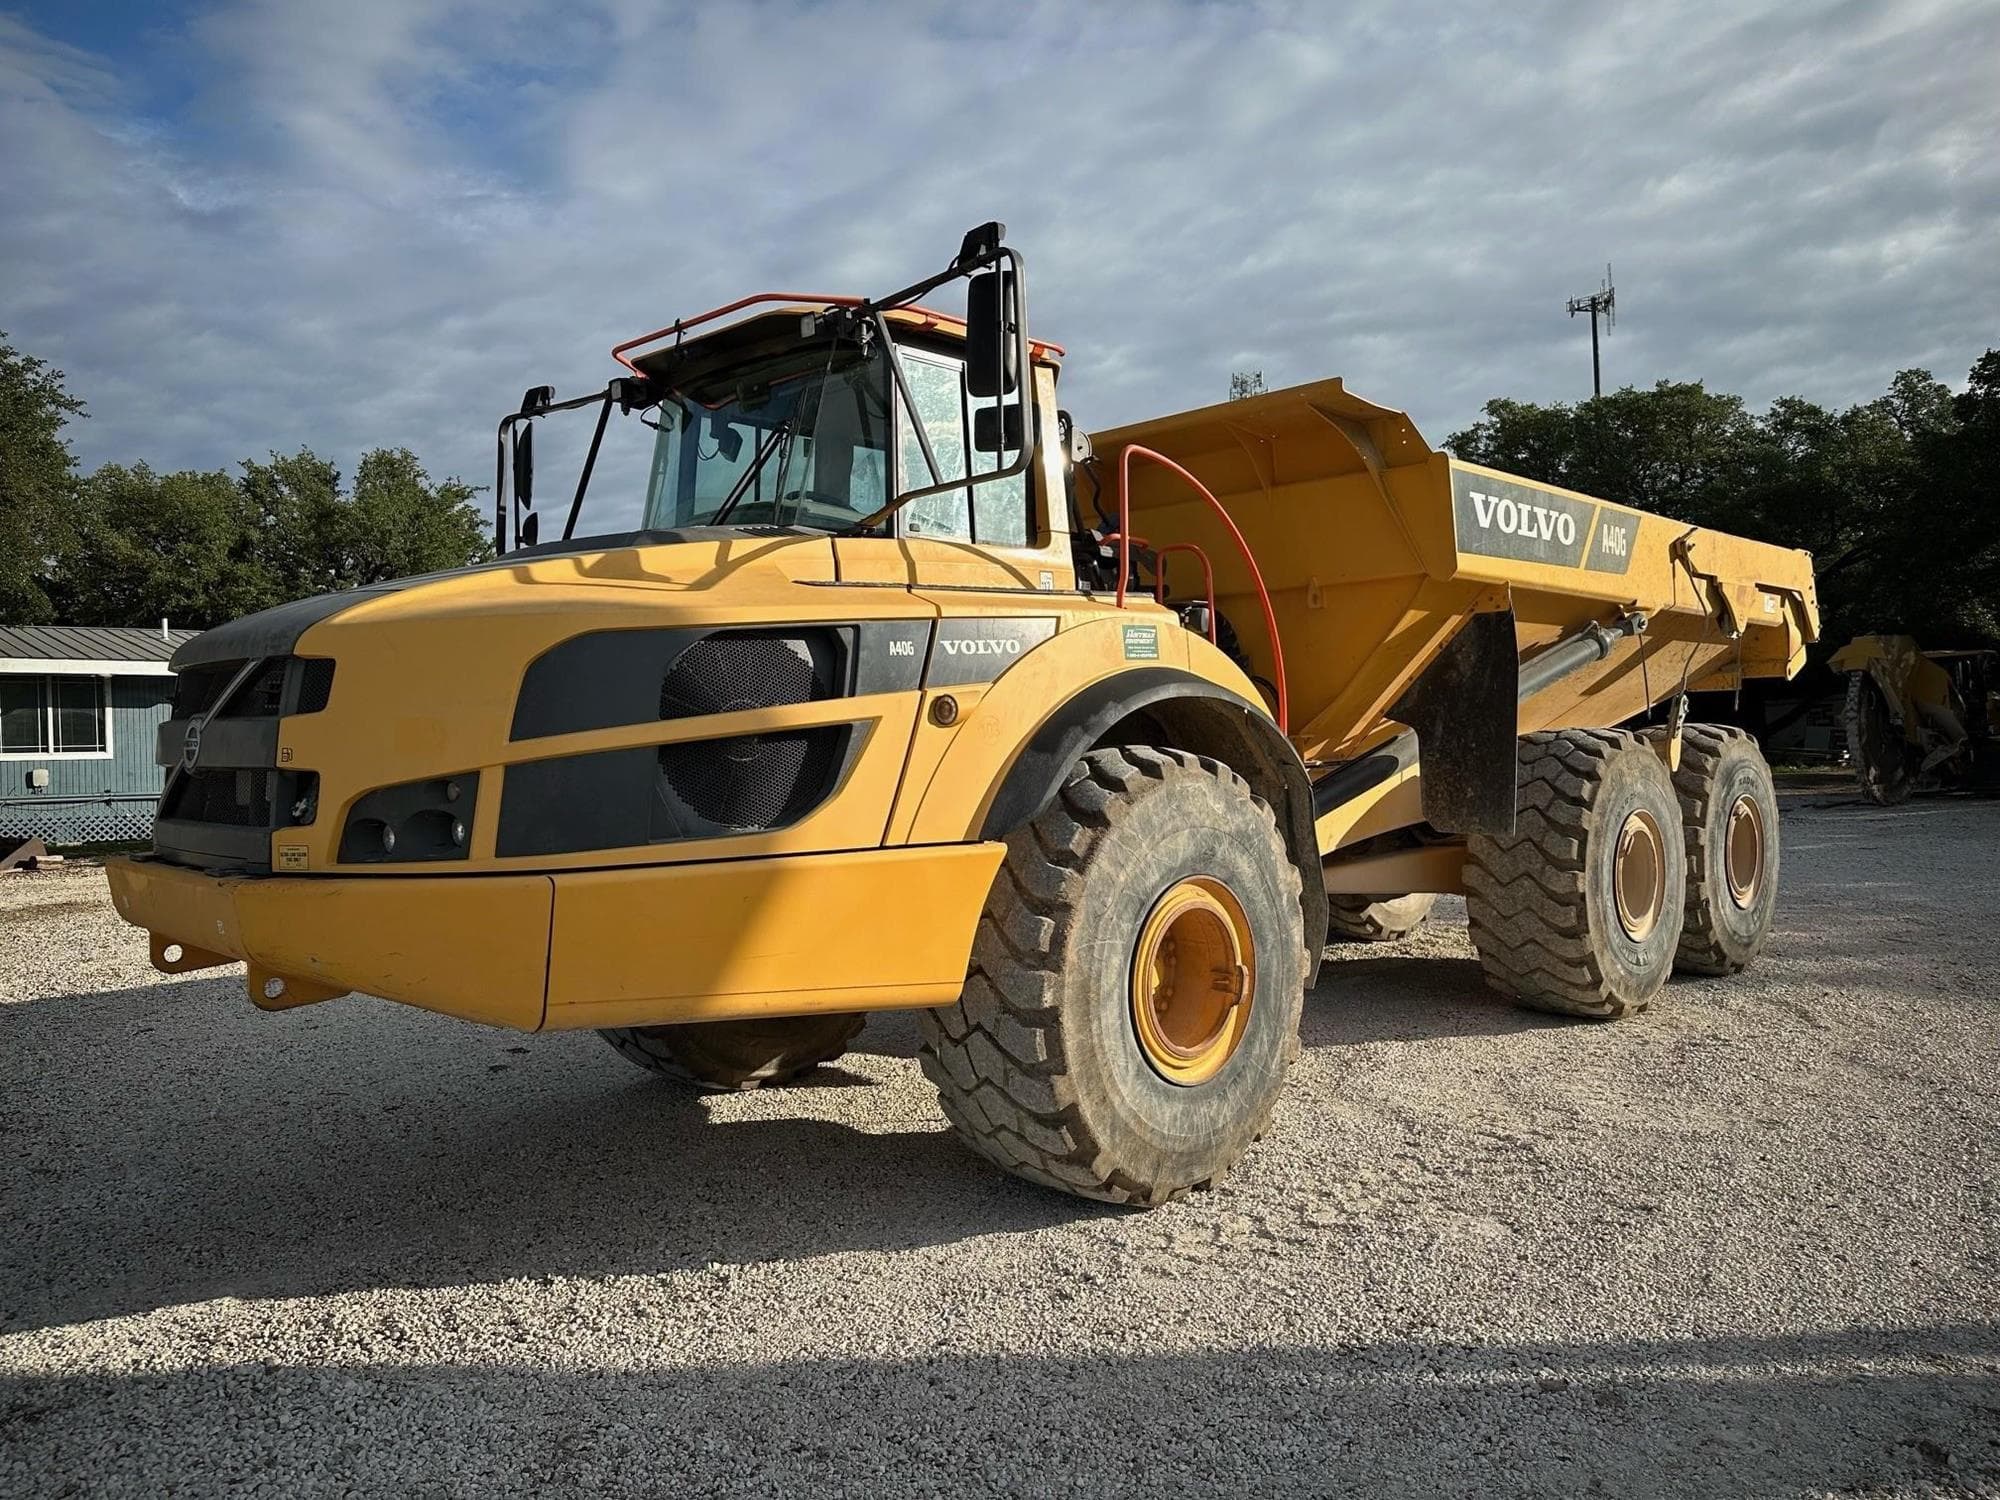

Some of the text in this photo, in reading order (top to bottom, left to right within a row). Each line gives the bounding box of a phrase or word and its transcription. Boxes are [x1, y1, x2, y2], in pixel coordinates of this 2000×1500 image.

[1469, 491, 1576, 546] VOLVO
[1602, 523, 1627, 557] A40G
[889, 641, 914, 656] A40G
[940, 639, 1020, 655] VOLVO
